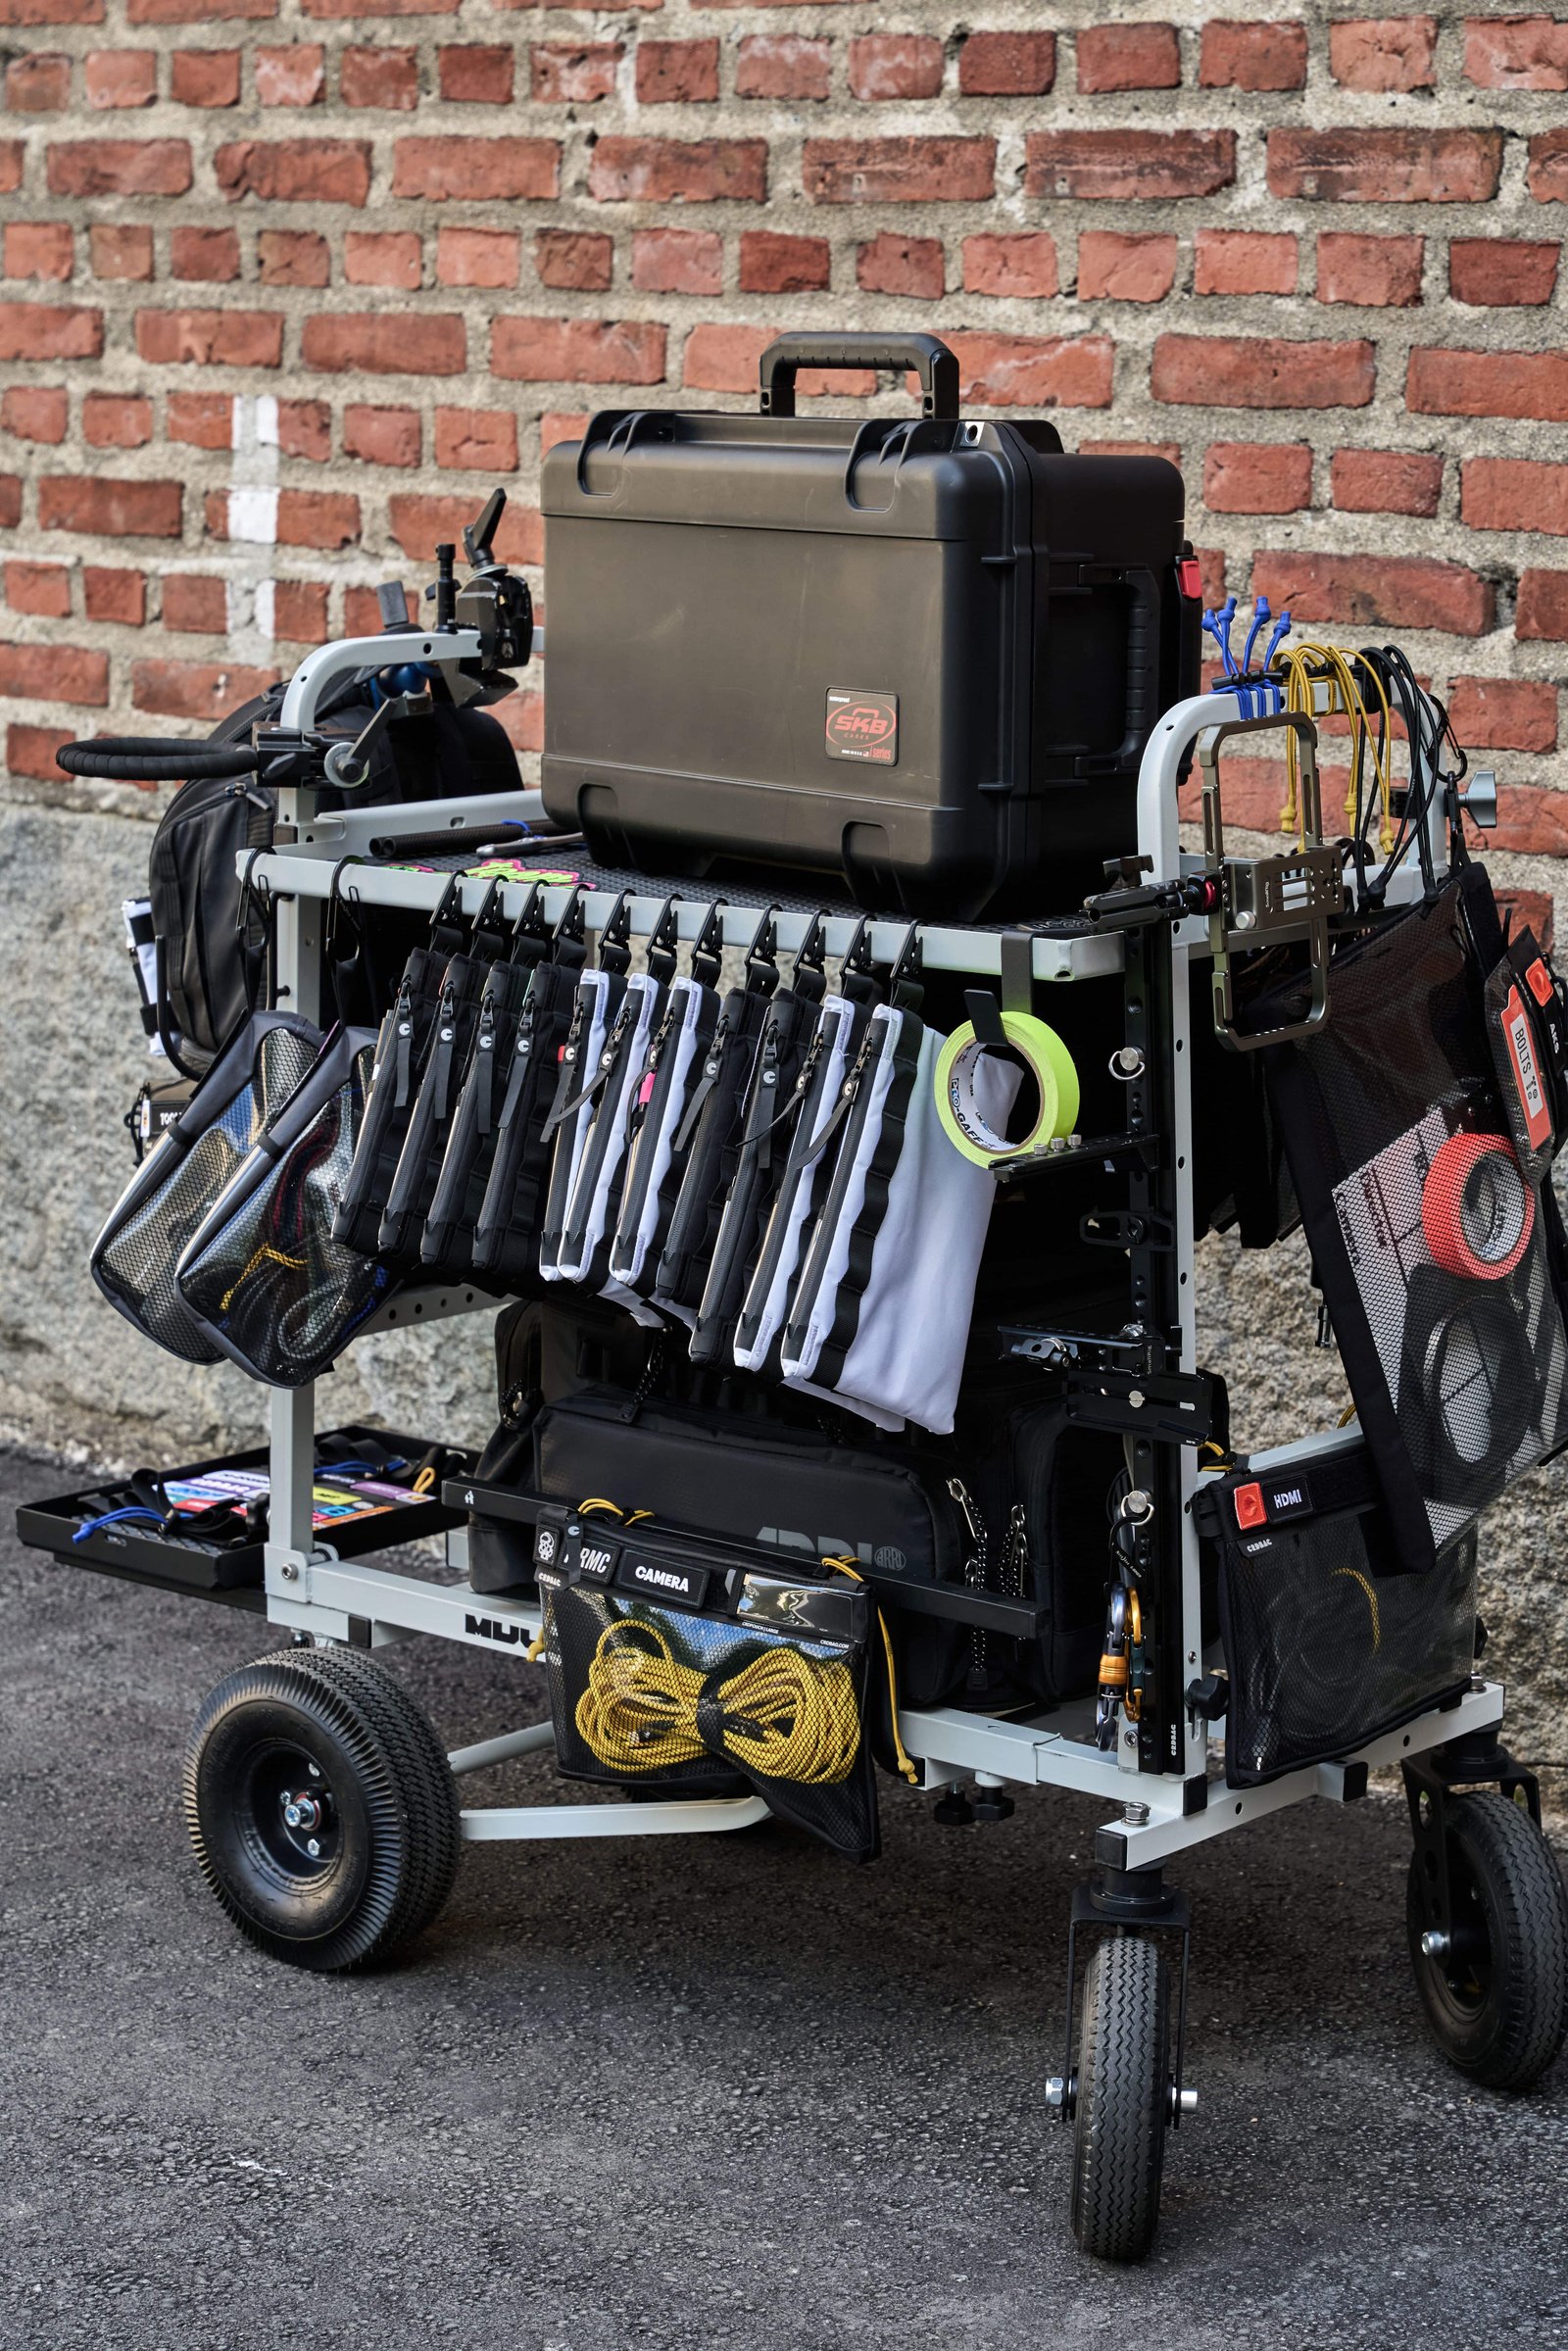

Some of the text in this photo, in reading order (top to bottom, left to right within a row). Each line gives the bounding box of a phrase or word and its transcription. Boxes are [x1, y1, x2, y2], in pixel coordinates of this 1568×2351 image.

[835, 715, 888, 734] SKB
[1514, 1027, 1532, 1075] BOLTS
[1548, 1022, 1560, 1055] AKS
[1273, 1489, 1302, 1509] HDMI
[564, 1547, 612, 1574] RMC
[874, 1546, 906, 1571] ARRI
[634, 1564, 690, 1593] CAMERA
